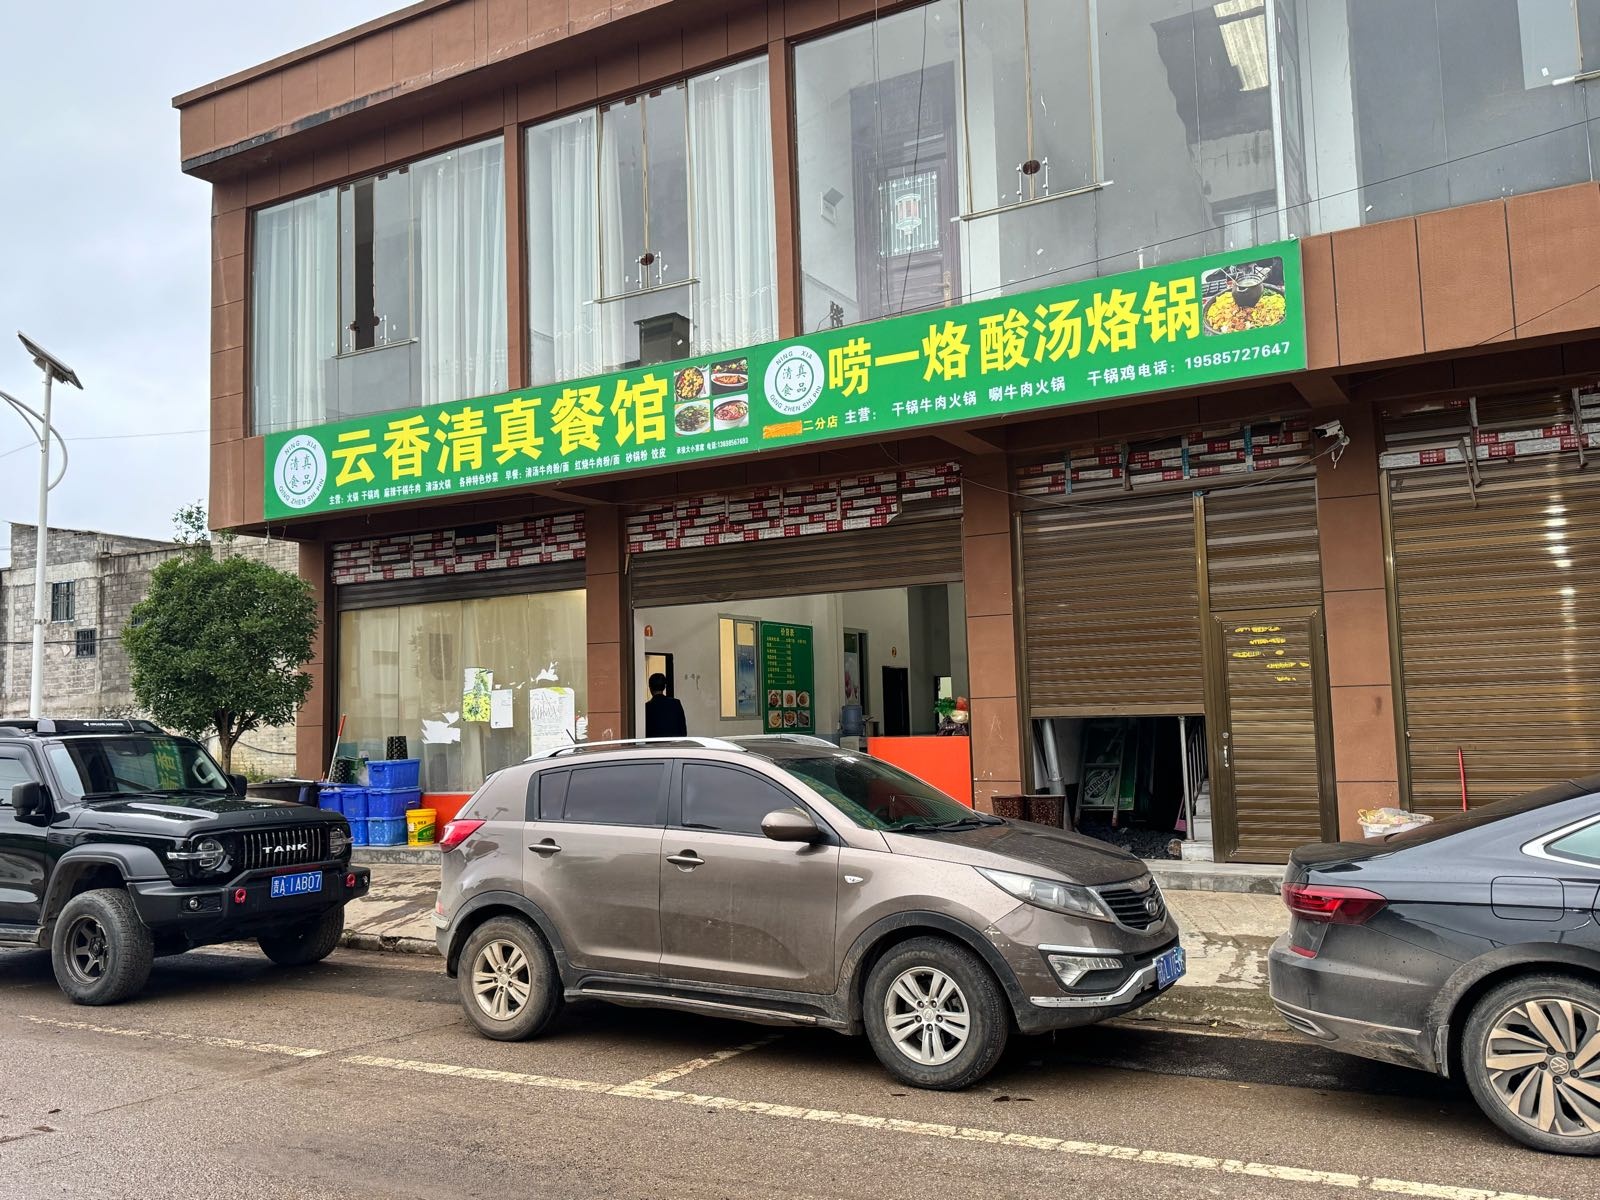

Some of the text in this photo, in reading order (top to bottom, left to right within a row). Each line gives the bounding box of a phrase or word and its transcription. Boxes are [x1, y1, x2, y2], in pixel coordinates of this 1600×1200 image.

[828, 277, 1201, 397] 唠一烙 酸汤烙锅
[776, 350, 813, 365] NING XIA
[1184, 341, 1291, 369] 19585727647
[783, 405, 801, 413] ZHEN
[802, 398, 814, 409] SHI
[813, 385, 822, 398] PIN
[331, 373, 668, 487] 云香清真餐馆
[802, 415, 838, 431] 二分店
[284, 440, 317, 456] NING XIA
[425, 479, 452, 492] 清汤火锅
[459, 472, 499, 487] 各种特色炒菜
[625, 449, 648, 463] 砂锅粉
[262, 843, 308, 854] TANK
